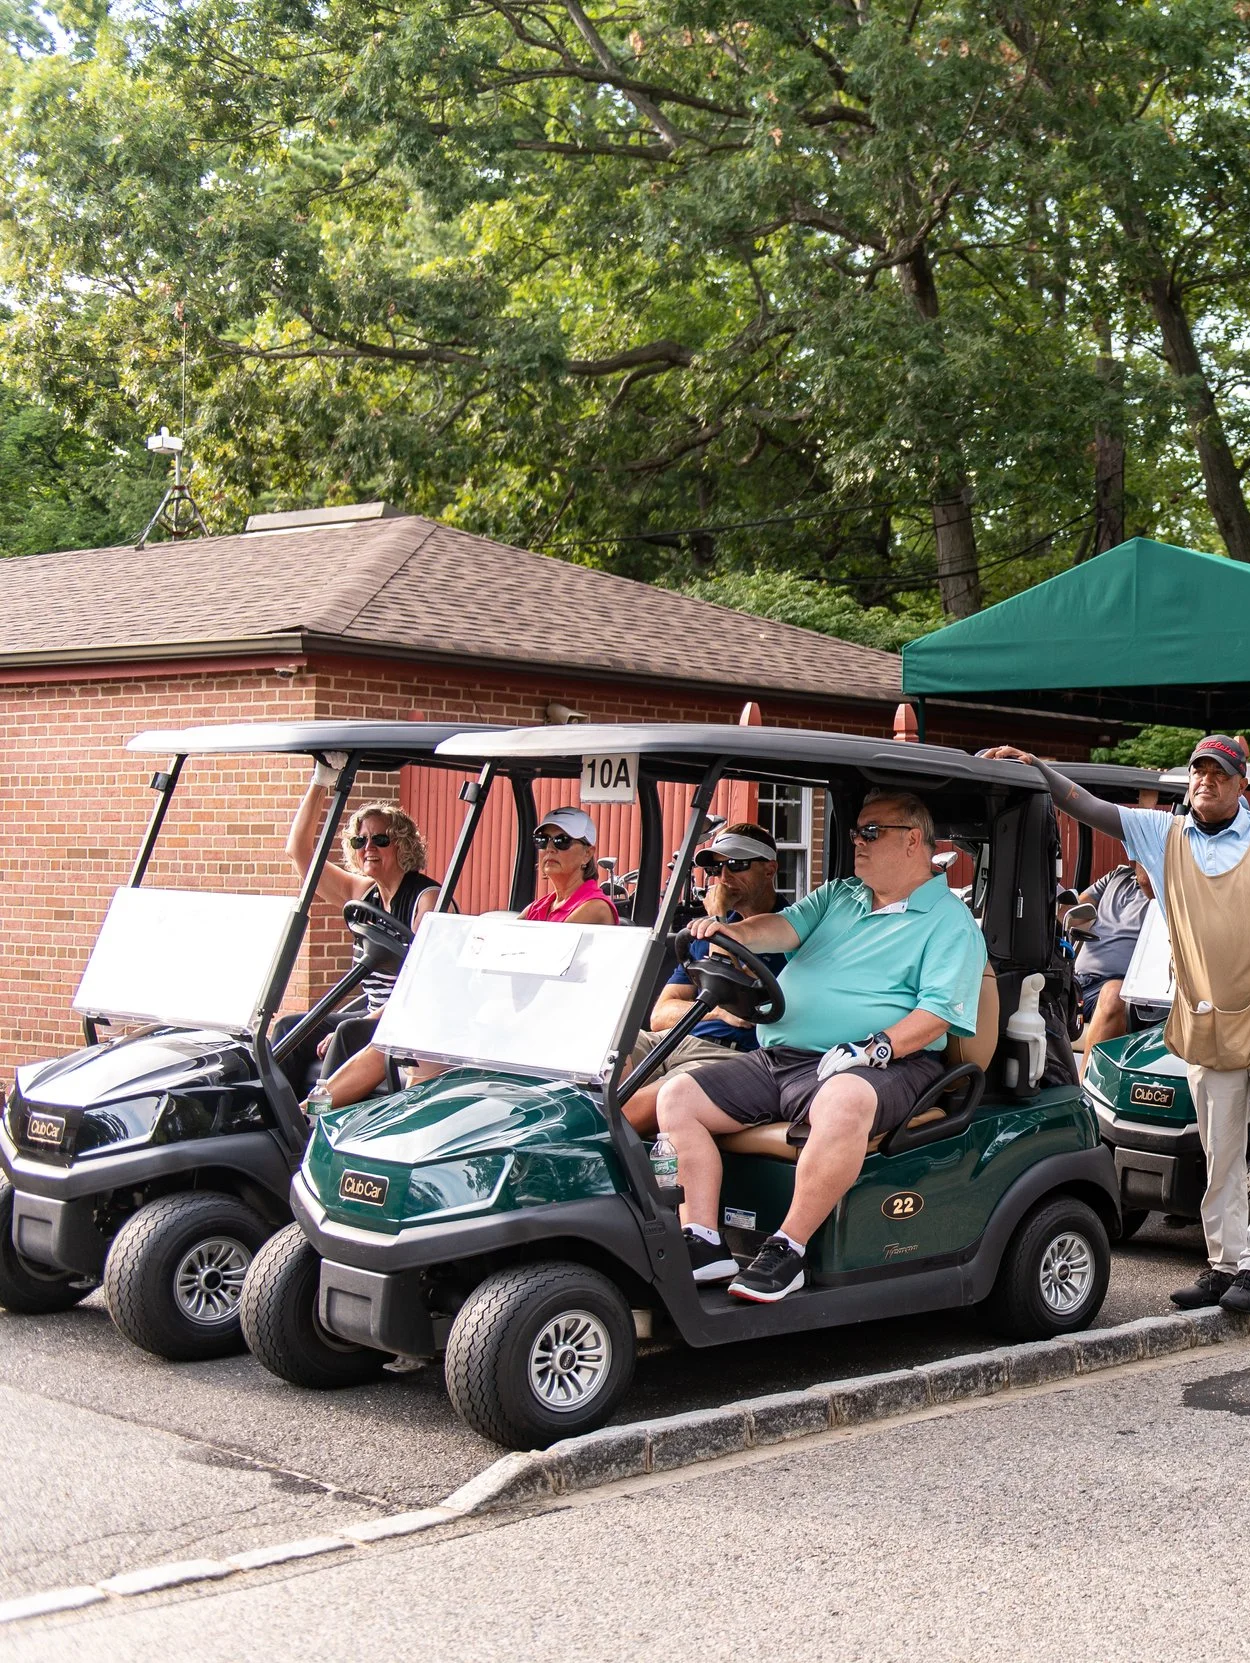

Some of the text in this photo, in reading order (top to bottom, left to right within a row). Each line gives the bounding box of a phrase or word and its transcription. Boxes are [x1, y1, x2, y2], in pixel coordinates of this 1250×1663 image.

[587, 758, 631, 788] 10A
[1135, 1088, 1169, 1103] Club Car
[31, 1120, 60, 1138] Club Car
[344, 1177, 382, 1199] Club Car
[893, 1197, 914, 1215] 22
